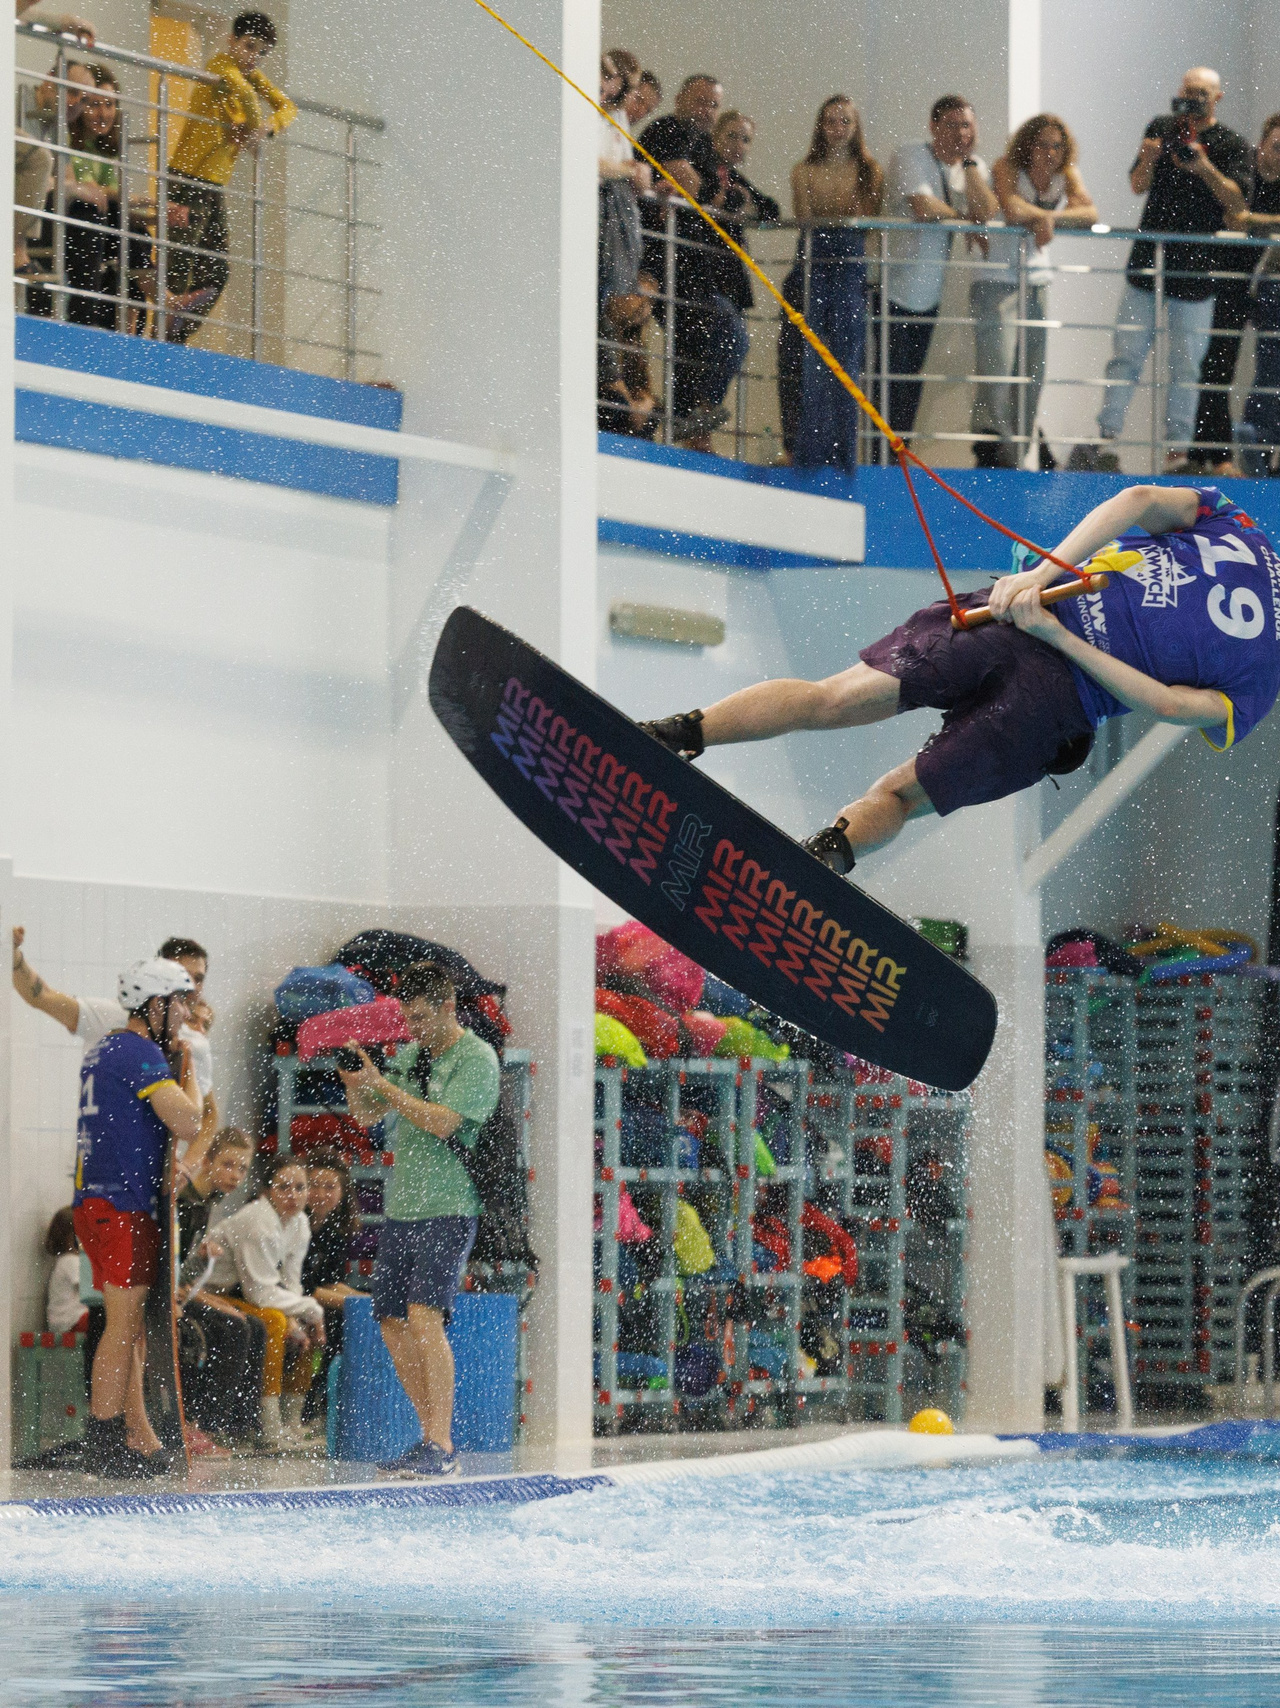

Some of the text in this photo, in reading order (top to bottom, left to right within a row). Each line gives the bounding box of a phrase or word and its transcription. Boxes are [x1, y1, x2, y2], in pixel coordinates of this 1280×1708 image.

[1193, 534, 1265, 640] 19
[490, 677, 531, 759] MIR
[512, 697, 554, 780] MIR
[533, 716, 577, 801] MIR
[557, 735, 602, 823] MIR
[580, 753, 627, 844] MIR
[604, 772, 652, 865] MIR
[629, 790, 678, 886] MIR
[661, 814, 713, 911] MIR
[694, 839, 744, 934] MIR
[721, 859, 770, 951] MIR
[748, 879, 797, 968] MIR
[775, 899, 824, 985] MIR
[803, 919, 851, 1002] MIR
[831, 938, 879, 1017] MIR
[860, 957, 907, 1033] MIR
